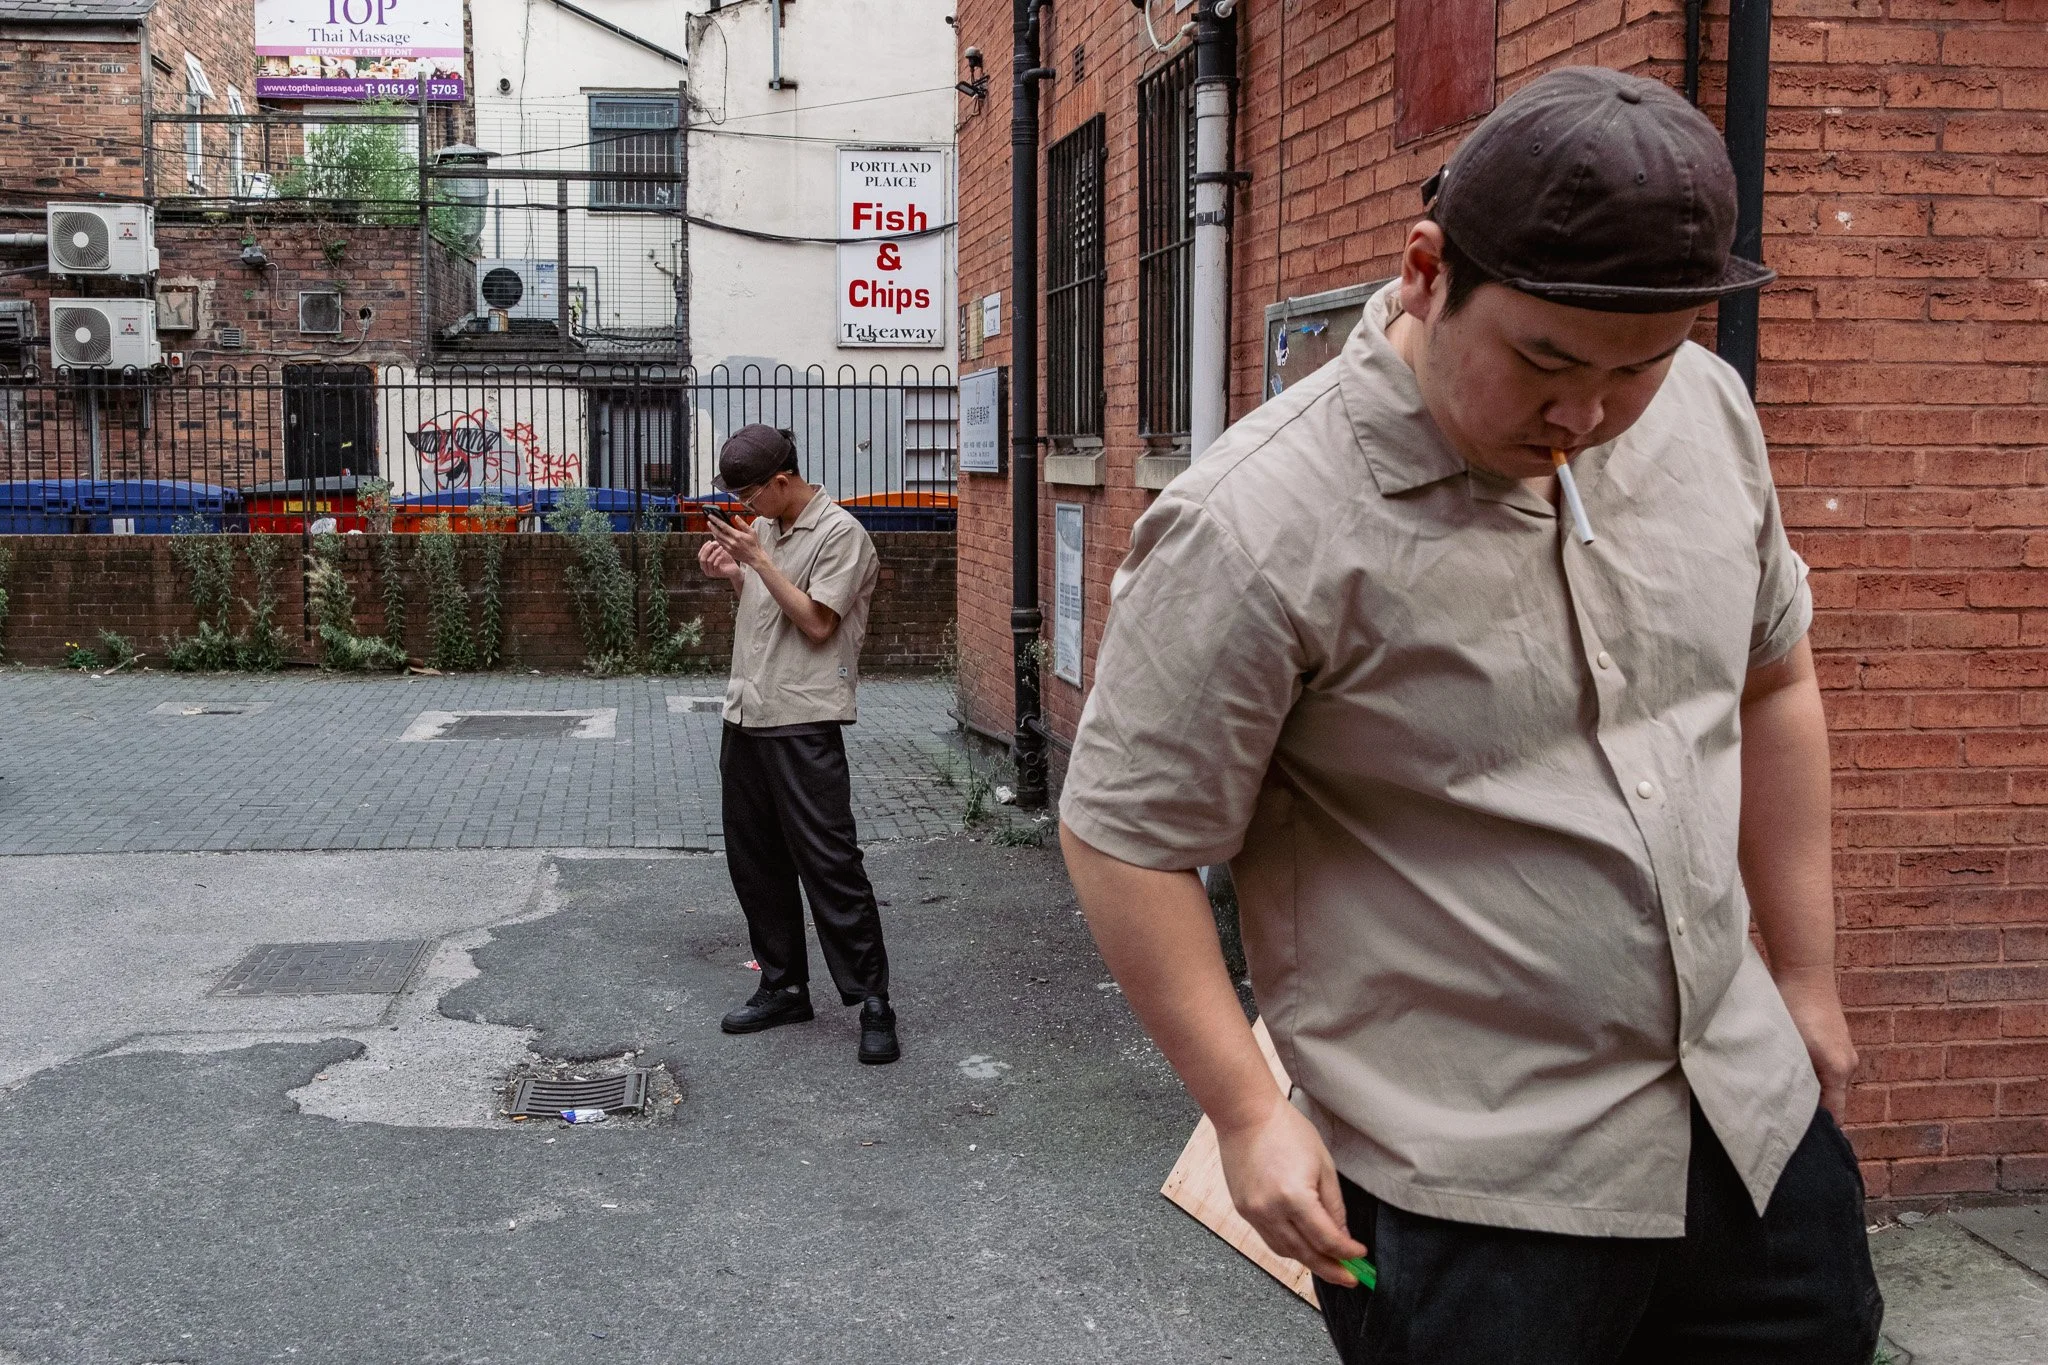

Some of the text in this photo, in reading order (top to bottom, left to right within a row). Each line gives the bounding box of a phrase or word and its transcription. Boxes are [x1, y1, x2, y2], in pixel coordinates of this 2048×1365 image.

[308, 28, 411, 46] Thai Massage
[305, 47, 414, 57] ENTRANCE AT THE FRONT
[263, 83, 365, 94] www.topthaimassage.uk
[365, 83, 375, 94] T:
[377, 83, 404, 95] 0161
[431, 84, 458, 95] 5703
[850, 161, 932, 173] PORTLAND
[865, 176, 917, 188] PLAICE
[852, 202, 927, 232] Fish
[876, 243, 902, 271] &
[848, 279, 930, 315] Chips
[843, 323, 938, 343] Takeaway
